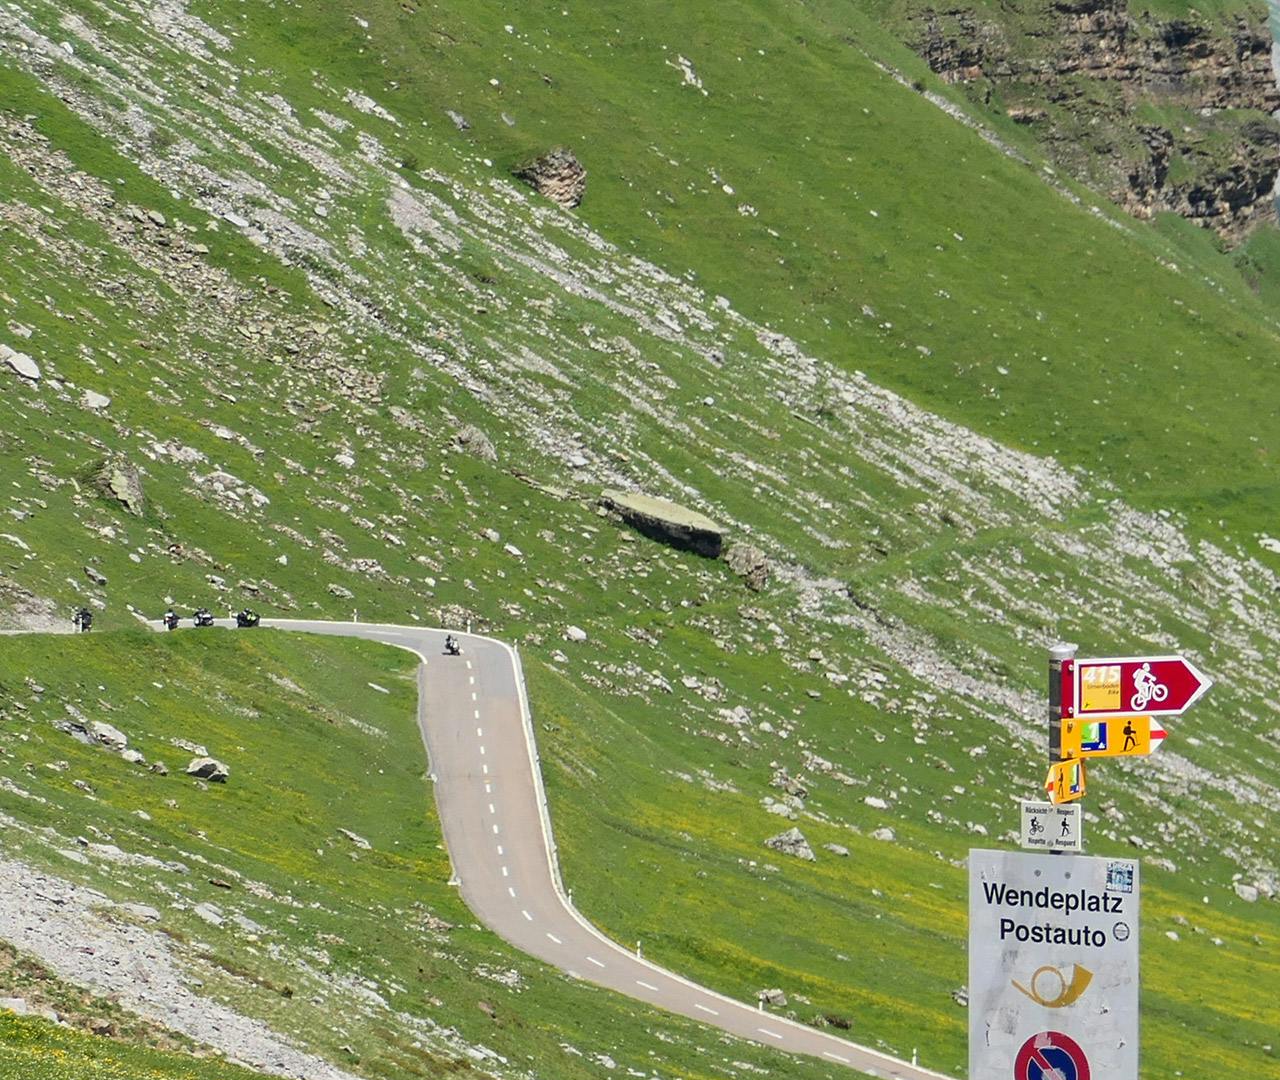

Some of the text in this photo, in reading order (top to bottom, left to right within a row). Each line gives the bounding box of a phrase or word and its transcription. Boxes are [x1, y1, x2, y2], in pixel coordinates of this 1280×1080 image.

[1084, 666, 1119, 684] 415
[983, 882, 1123, 916] Wendeplatz
[1000, 918, 1106, 948] Postauto
